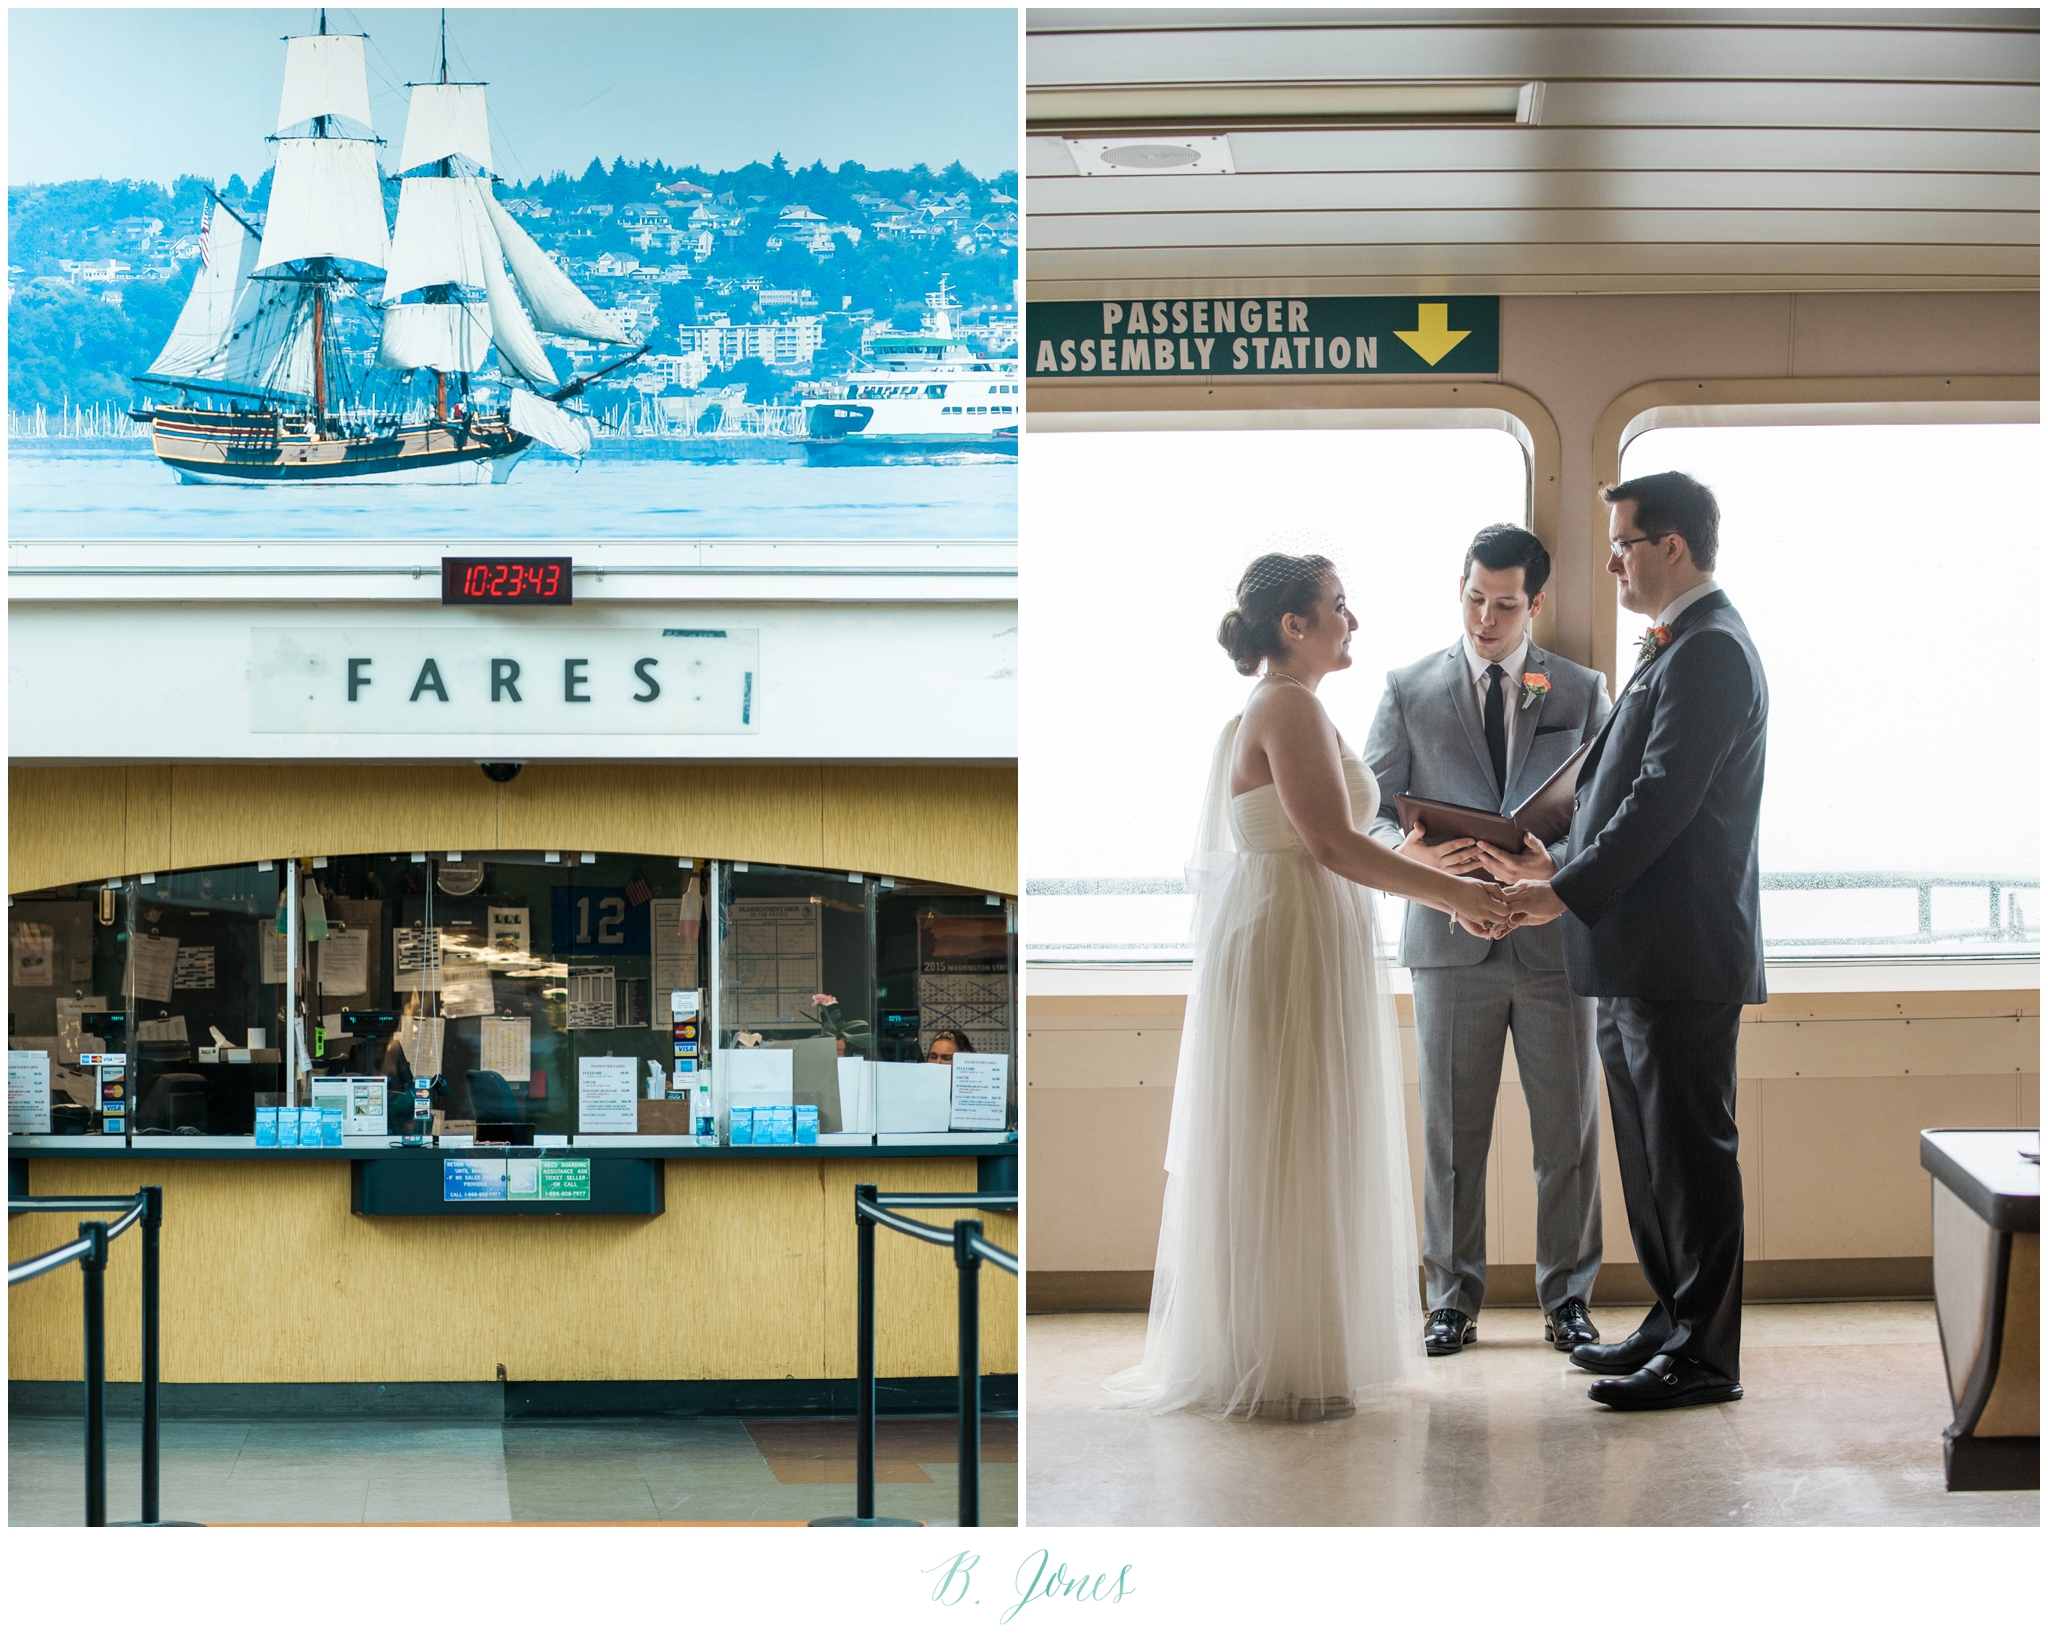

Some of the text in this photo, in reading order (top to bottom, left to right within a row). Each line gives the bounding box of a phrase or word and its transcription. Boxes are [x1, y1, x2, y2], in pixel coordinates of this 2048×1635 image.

[1101, 300, 1310, 334] PASSENGER
[1035, 335, 1378, 372] ASSEMBLY STATION
[463, 565, 561, 596] 10:23:43
[346, 657, 661, 703] FARES
[576, 896, 626, 944] 12
[924, 961, 946, 971] 2015
